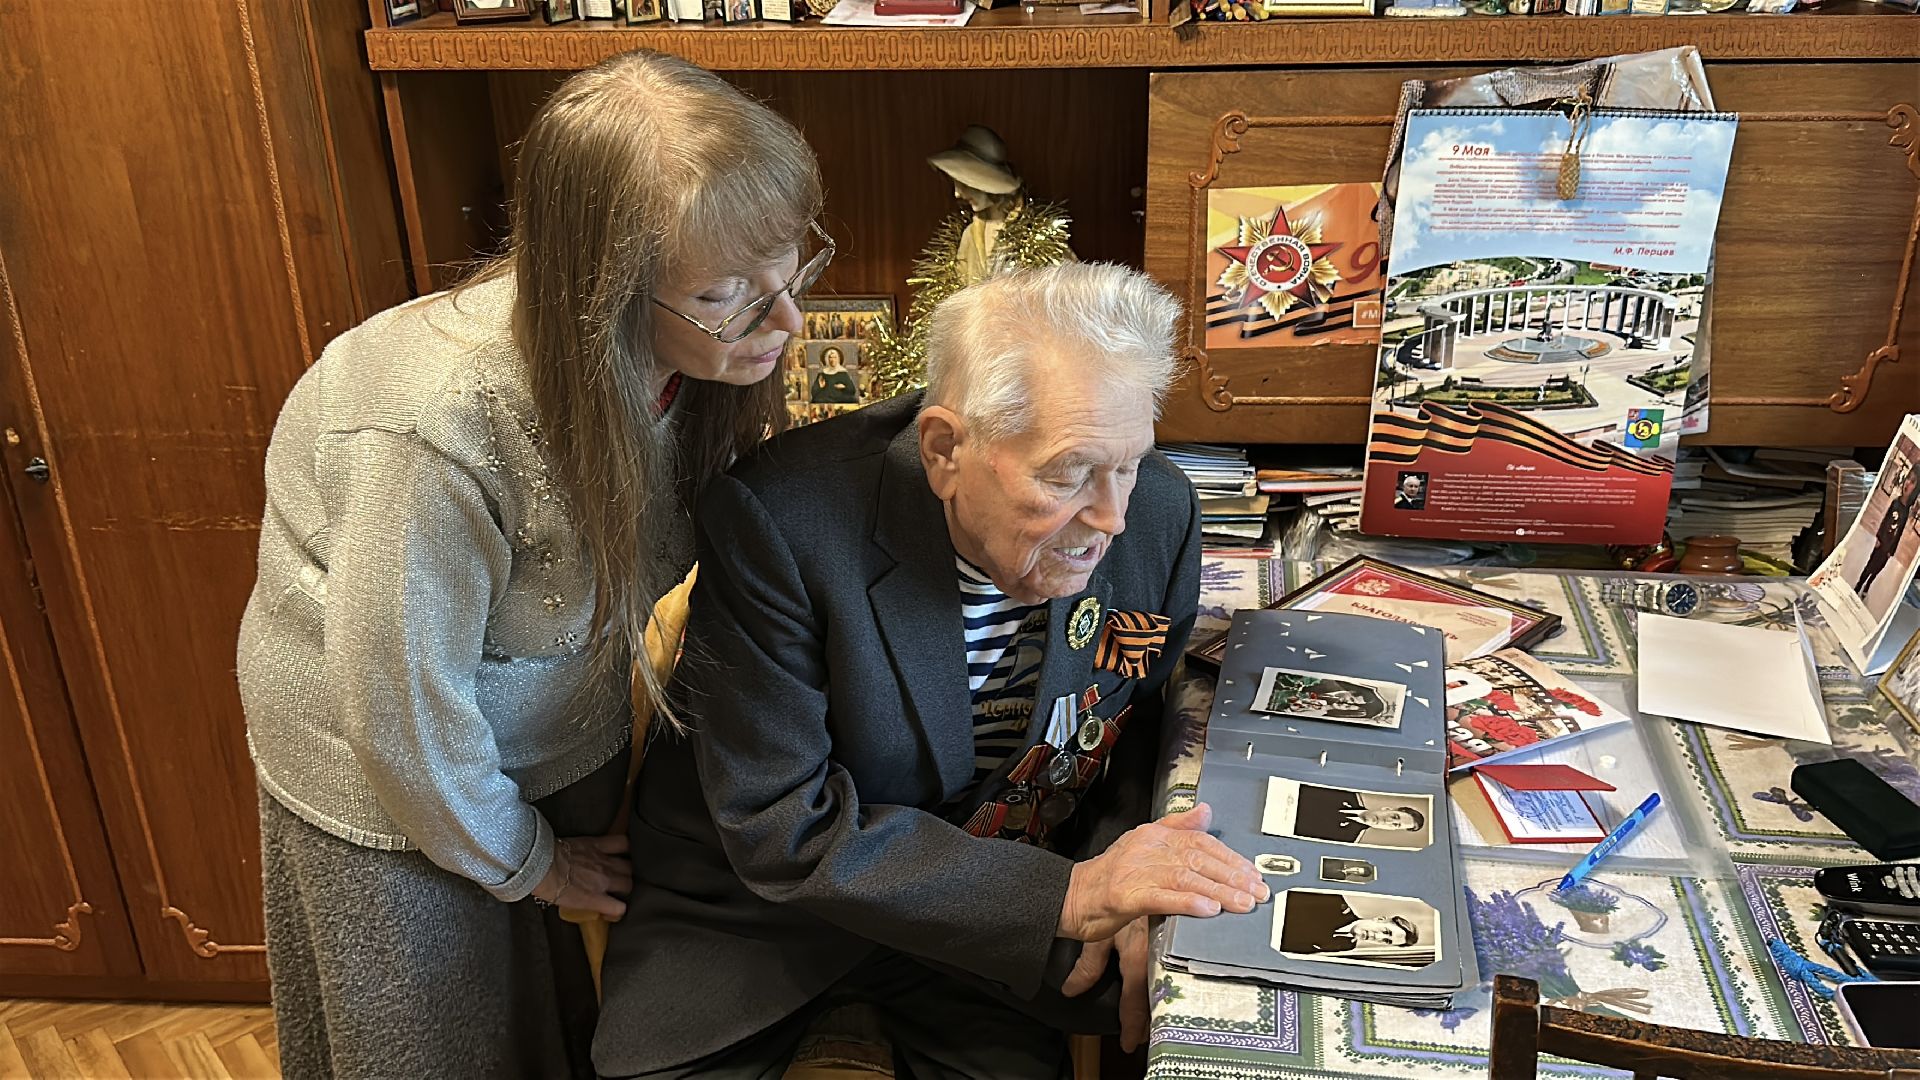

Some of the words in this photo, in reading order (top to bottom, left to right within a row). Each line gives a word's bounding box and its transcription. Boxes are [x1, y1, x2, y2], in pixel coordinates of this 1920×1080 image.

[1453, 144, 1460, 156] 9
[1462, 145, 1490, 157] Мая
[1248, 236, 1305, 287] ОТЕЧЕСТВЕННАЯ
[1347, 241, 1380, 284] 9
[1637, 247, 1675, 258] Перцев
[1846, 873, 1863, 893] Wink
